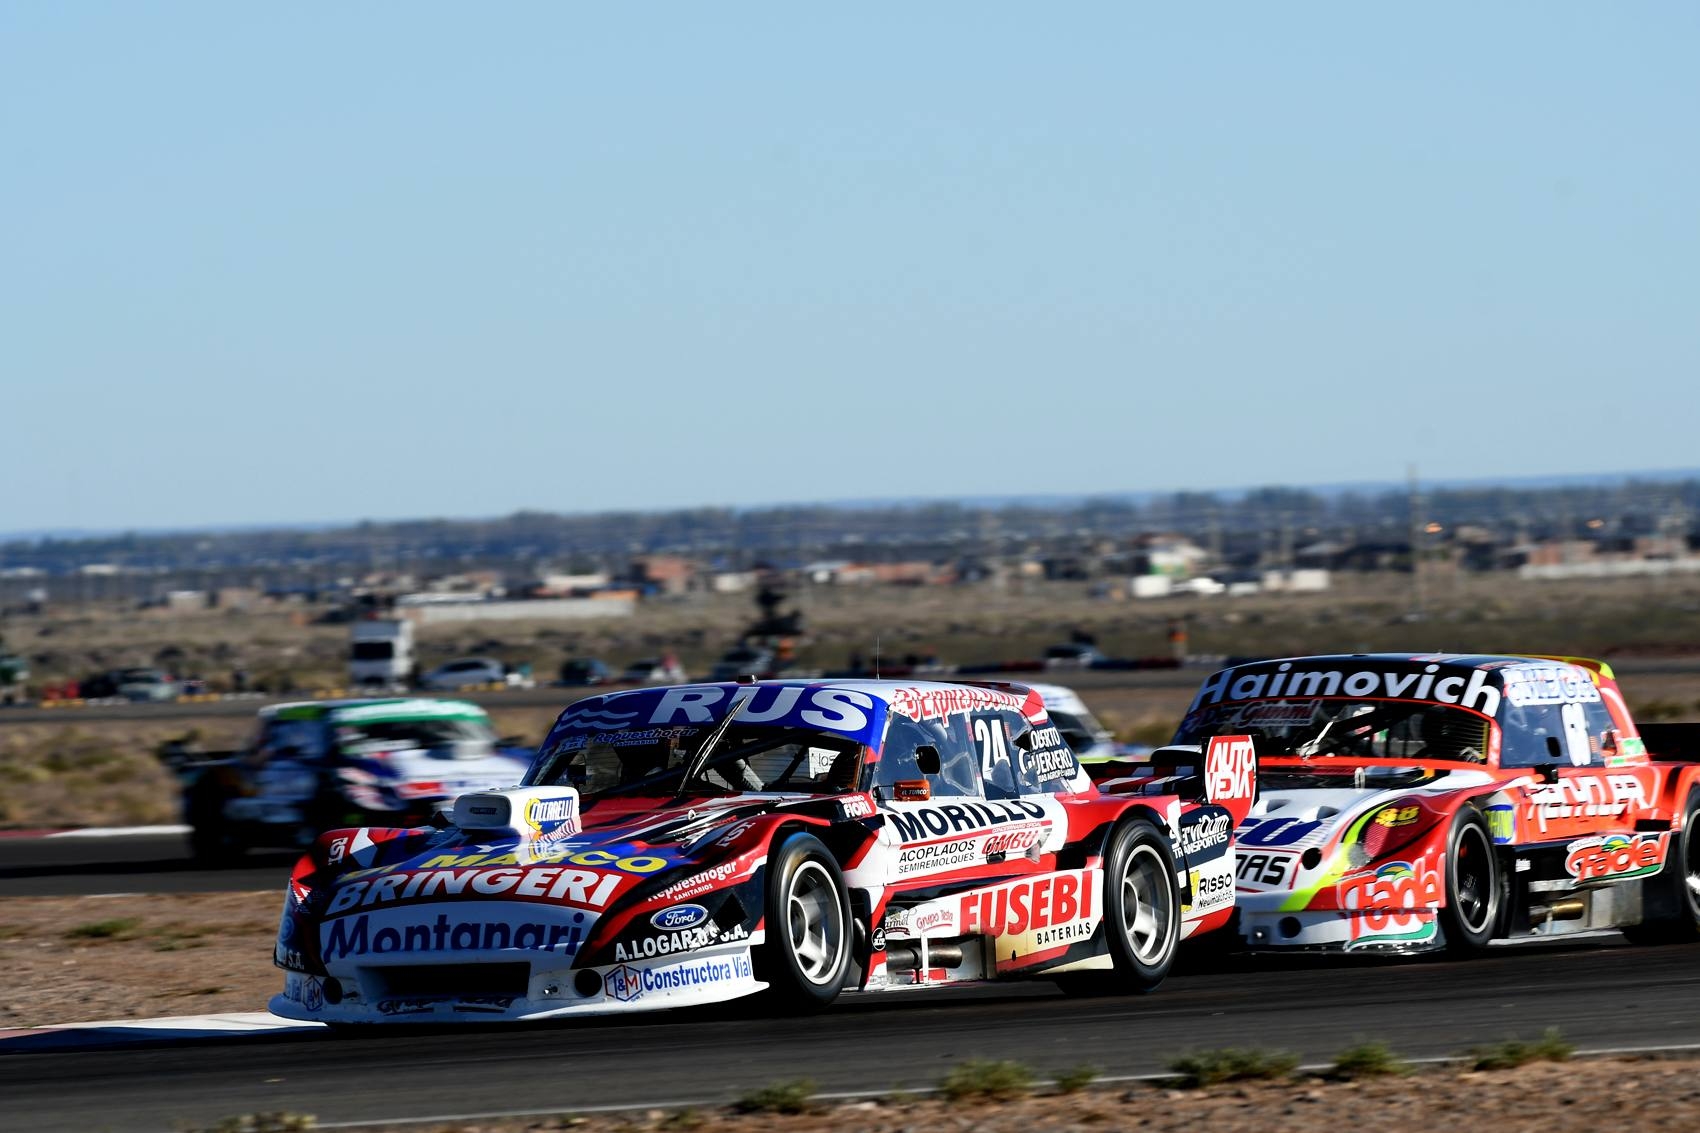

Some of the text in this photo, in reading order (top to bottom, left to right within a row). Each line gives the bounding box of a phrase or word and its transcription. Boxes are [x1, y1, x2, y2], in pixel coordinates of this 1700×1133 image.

[1188, 661, 1500, 718] Haimovich
[648, 686, 873, 731] RUS
[974, 718, 1011, 780] 24
[1210, 741, 1254, 773] AUTO
[887, 799, 1046, 843] MORILLO
[898, 852, 975, 874] SEMIREMOLQUES
[899, 839, 976, 864] ACOPLADOS
[324, 867, 623, 917] BRINGERI
[674, 883, 713, 901] SANITARIOS
[1199, 872, 1232, 897] RISSO
[665, 910, 696, 927] Ford
[1037, 921, 1092, 945] BATERIAS
[323, 912, 585, 964] Montanari
[643, 961, 731, 991] Constructora
[732, 955, 752, 978] Vial
